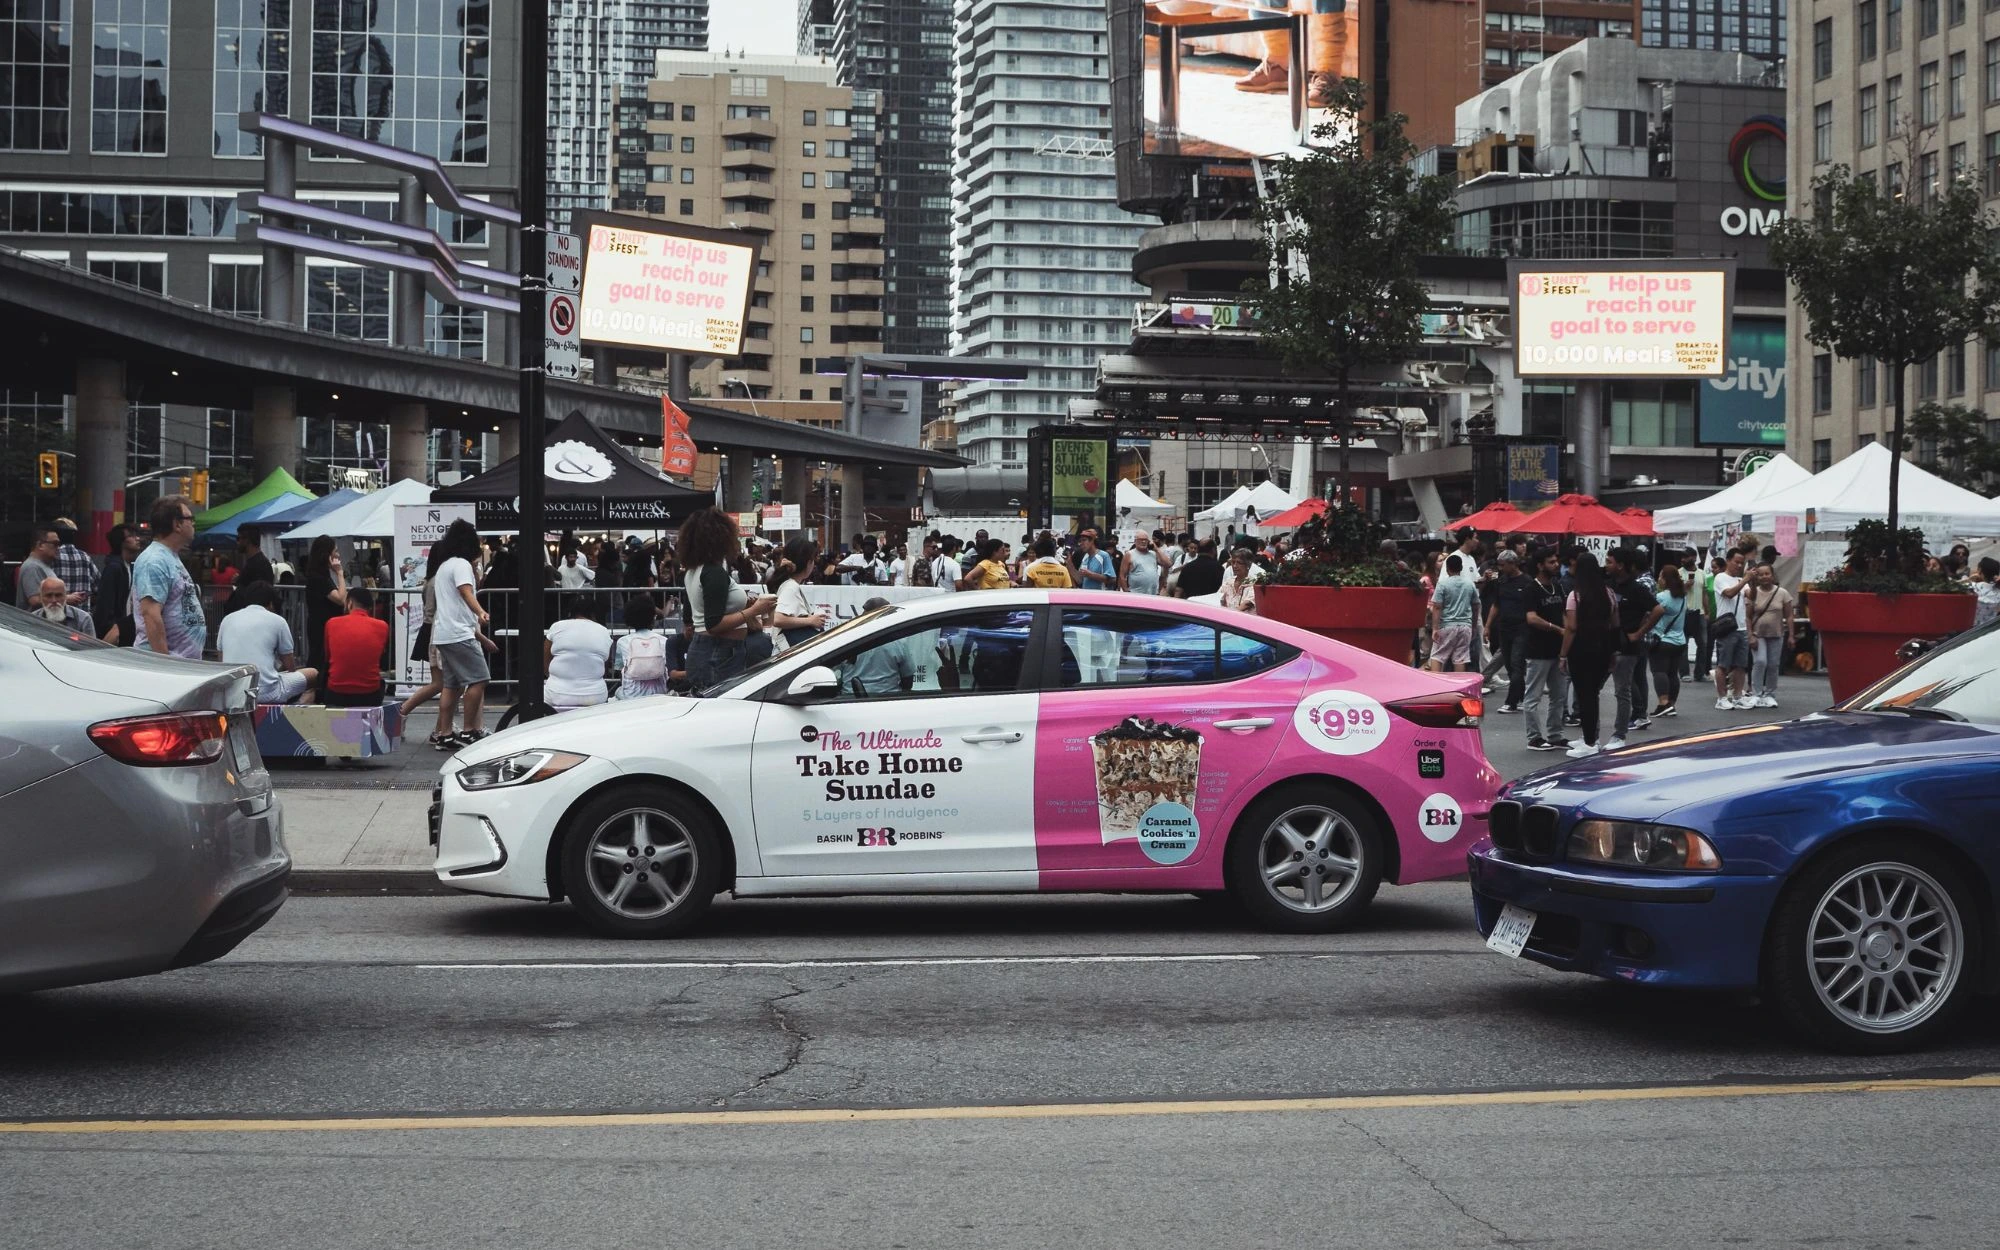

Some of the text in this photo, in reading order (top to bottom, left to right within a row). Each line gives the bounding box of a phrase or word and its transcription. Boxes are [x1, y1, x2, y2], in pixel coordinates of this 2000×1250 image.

[1720, 206, 1787, 236] OM
[558, 236, 569, 250] NO
[617, 232, 648, 246] UNITY
[616, 243, 638, 255] FEST
[663, 239, 728, 266] Help us
[547, 252, 579, 271] STANDING
[641, 262, 729, 288] reach our
[1552, 275, 1588, 285] UNITY
[1552, 286, 1577, 294] FEST
[1609, 275, 1692, 297] Help us
[609, 283, 725, 310] goal to serve
[1586, 296, 1696, 313] reach our
[1213, 306, 1232, 325] 20
[584, 308, 701, 338] 10,000 Meals
[1550, 317, 1696, 340] goal to serve
[706, 326, 738, 335] VOLUNTEER
[706, 334, 735, 343] FOR MORE
[1523, 345, 1673, 365] 10,000 Meals
[1055, 442, 1093, 453] EVENTS
[1510, 447, 1546, 458] EVENTS
[1055, 453, 1089, 465] AT THE
[1511, 458, 1542, 469] AT THE
[1055, 465, 1094, 477] SQUARE
[1511, 469, 1548, 481] SQUARE
[479, 501, 598, 512] DE SA SSOCIATES
[609, 502, 654, 511] LAWYERS
[609, 511, 671, 519] PARALEGALS
[1578, 538, 1600, 550] BAR
[816, 729, 942, 751] The Ultimate
[1414, 739, 1446, 749] Order @
[796, 753, 963, 777] Take Home
[1421, 755, 1440, 764] Uber
[1421, 764, 1441, 772] Eats
[826, 778, 935, 801] Sundae
[803, 807, 959, 823] 5 Layers of Indulgence
[1425, 808, 1457, 826] BR
[1145, 818, 1192, 826] Caramel
[817, 834, 853, 843] BASKIN
[857, 827, 897, 847] BR
[1141, 829, 1183, 838] Cookies
[1150, 841, 1186, 849] Cream
